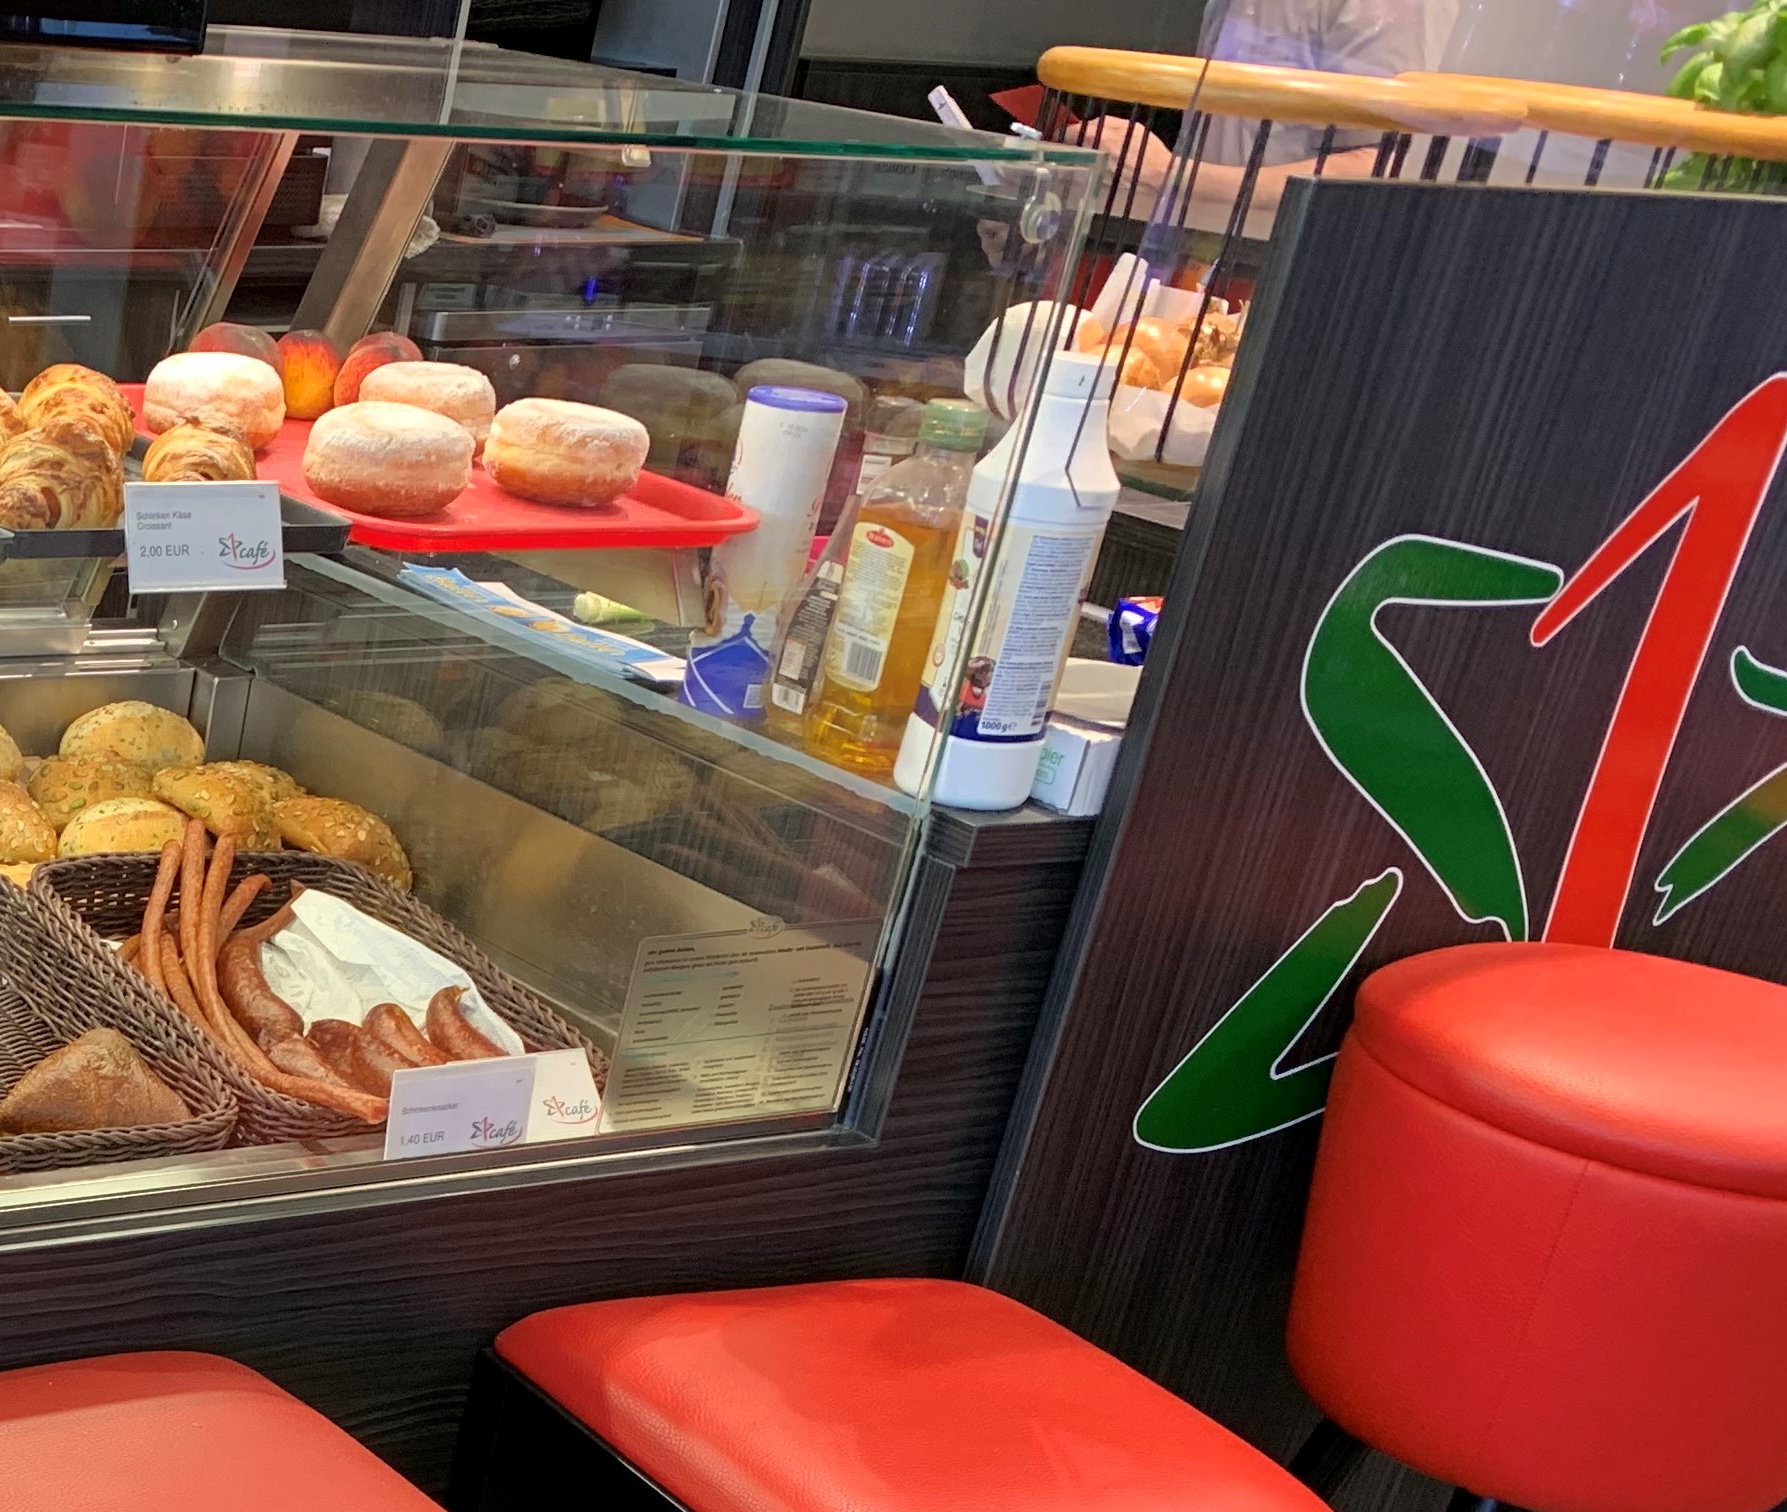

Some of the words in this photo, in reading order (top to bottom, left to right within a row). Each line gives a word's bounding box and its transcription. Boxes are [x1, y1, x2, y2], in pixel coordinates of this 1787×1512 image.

[136, 511, 170, 521] Schinken
[172, 510, 192, 519] Käse
[137, 521, 172, 531] Croissant
[140, 545, 162, 558] 2,00
[165, 544, 190, 557] EUR
[981, 721, 1001, 730] 1000
[423, 1130, 445, 1144] EUR
